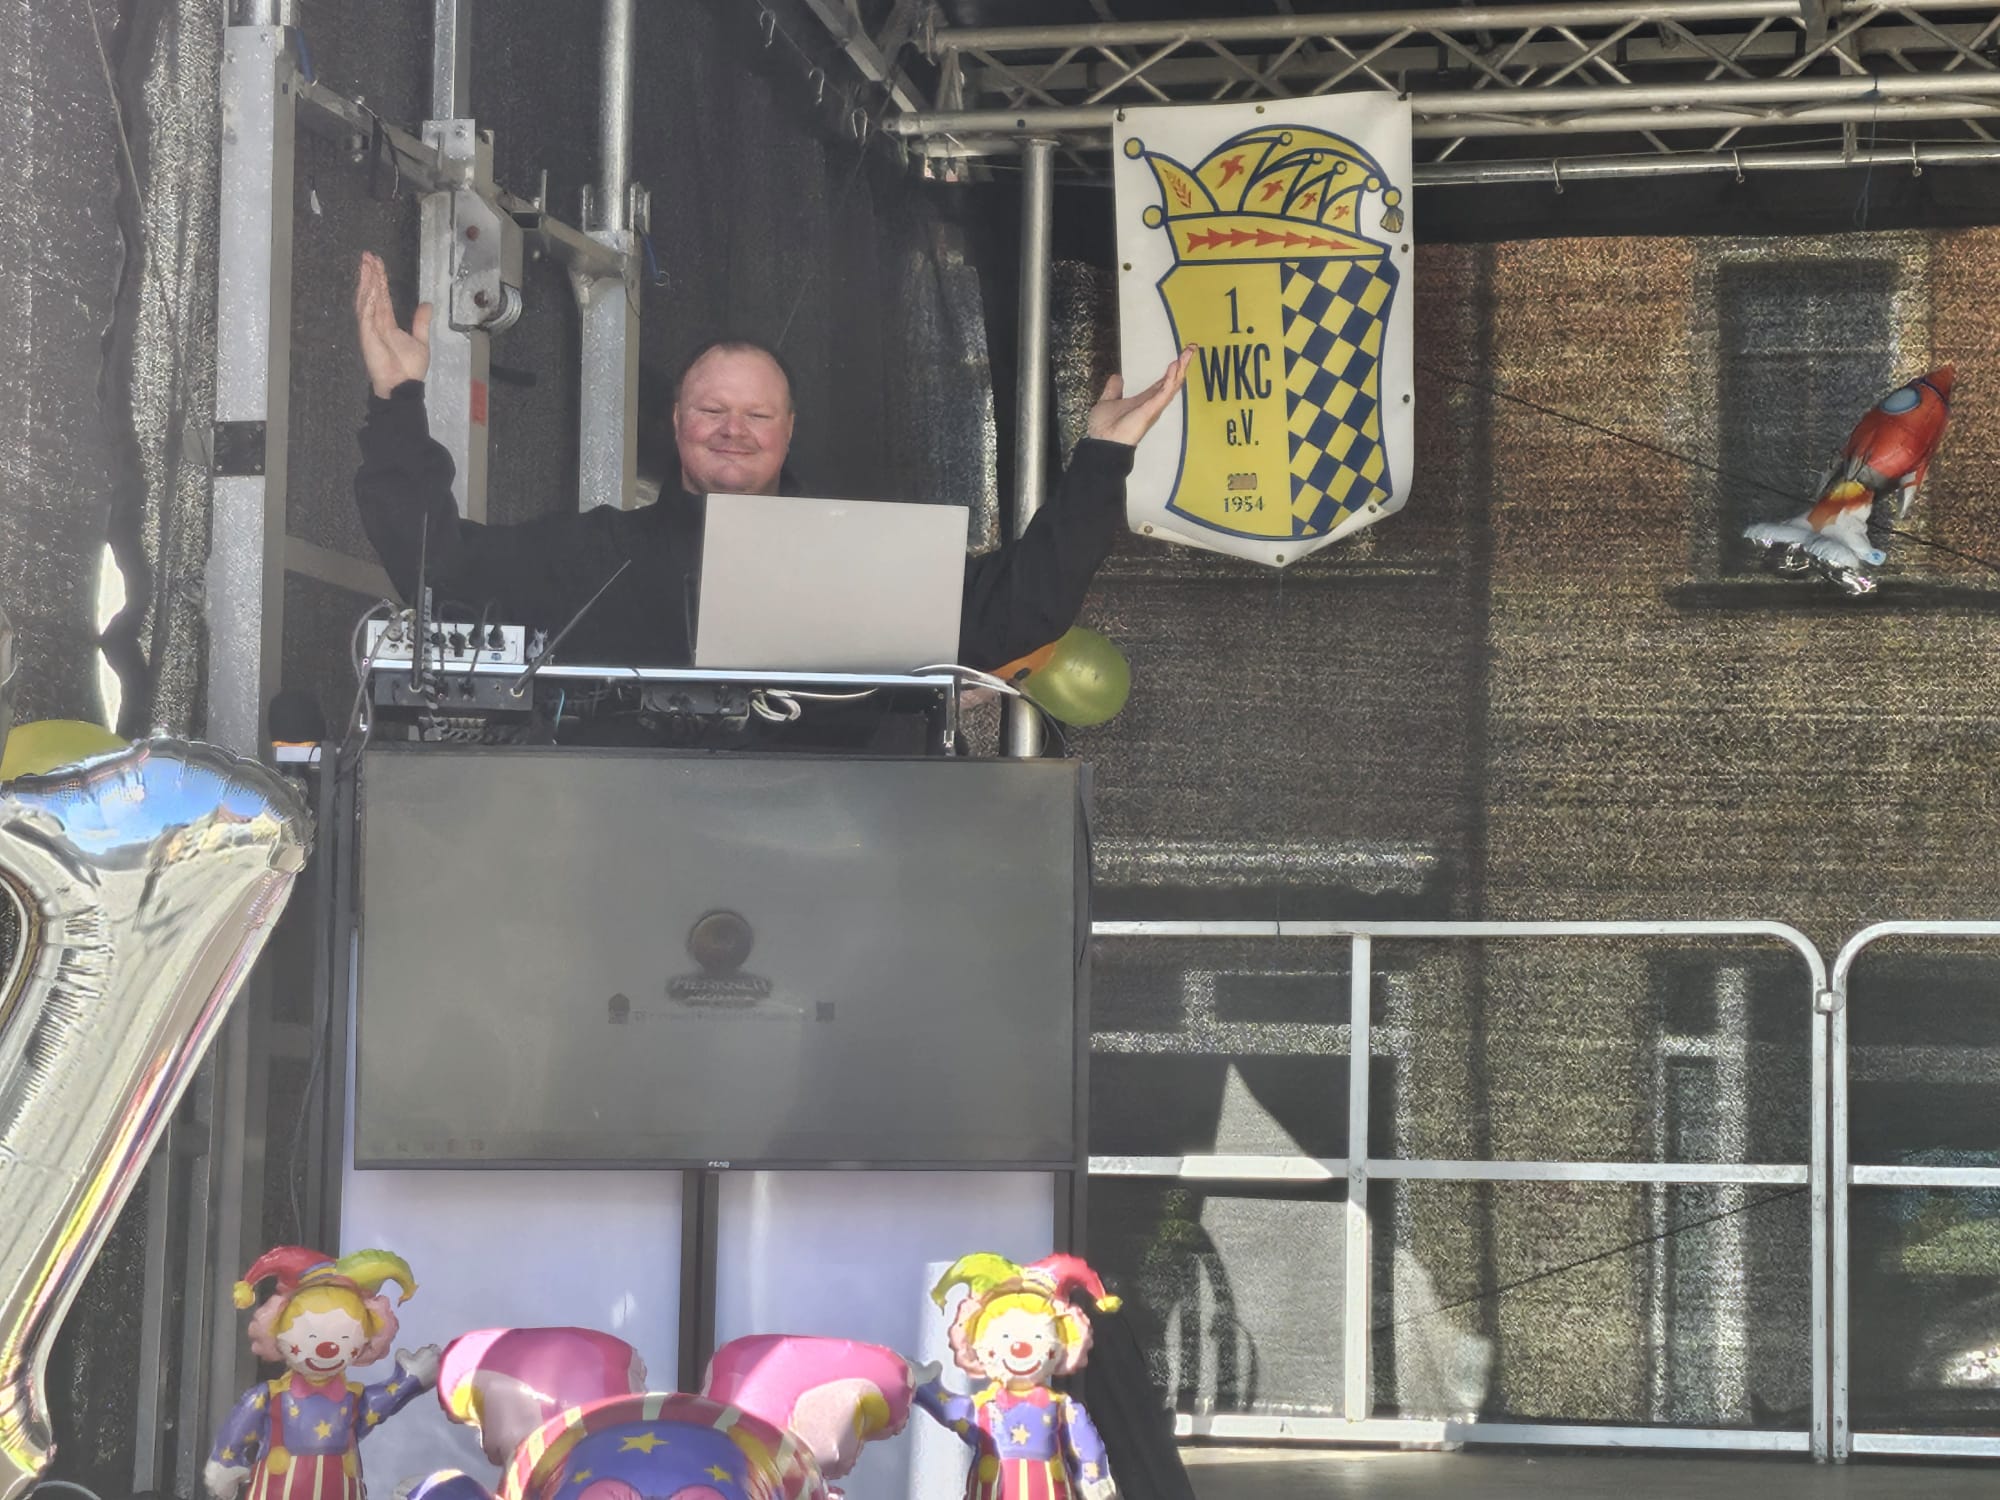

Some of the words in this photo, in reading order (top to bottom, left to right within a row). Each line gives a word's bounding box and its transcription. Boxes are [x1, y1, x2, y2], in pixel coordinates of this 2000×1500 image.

[1224, 285, 1255, 334] 1.
[1199, 343, 1272, 402] WKC
[1226, 408, 1259, 446] e.V.
[1223, 495, 1265, 513] 1954
